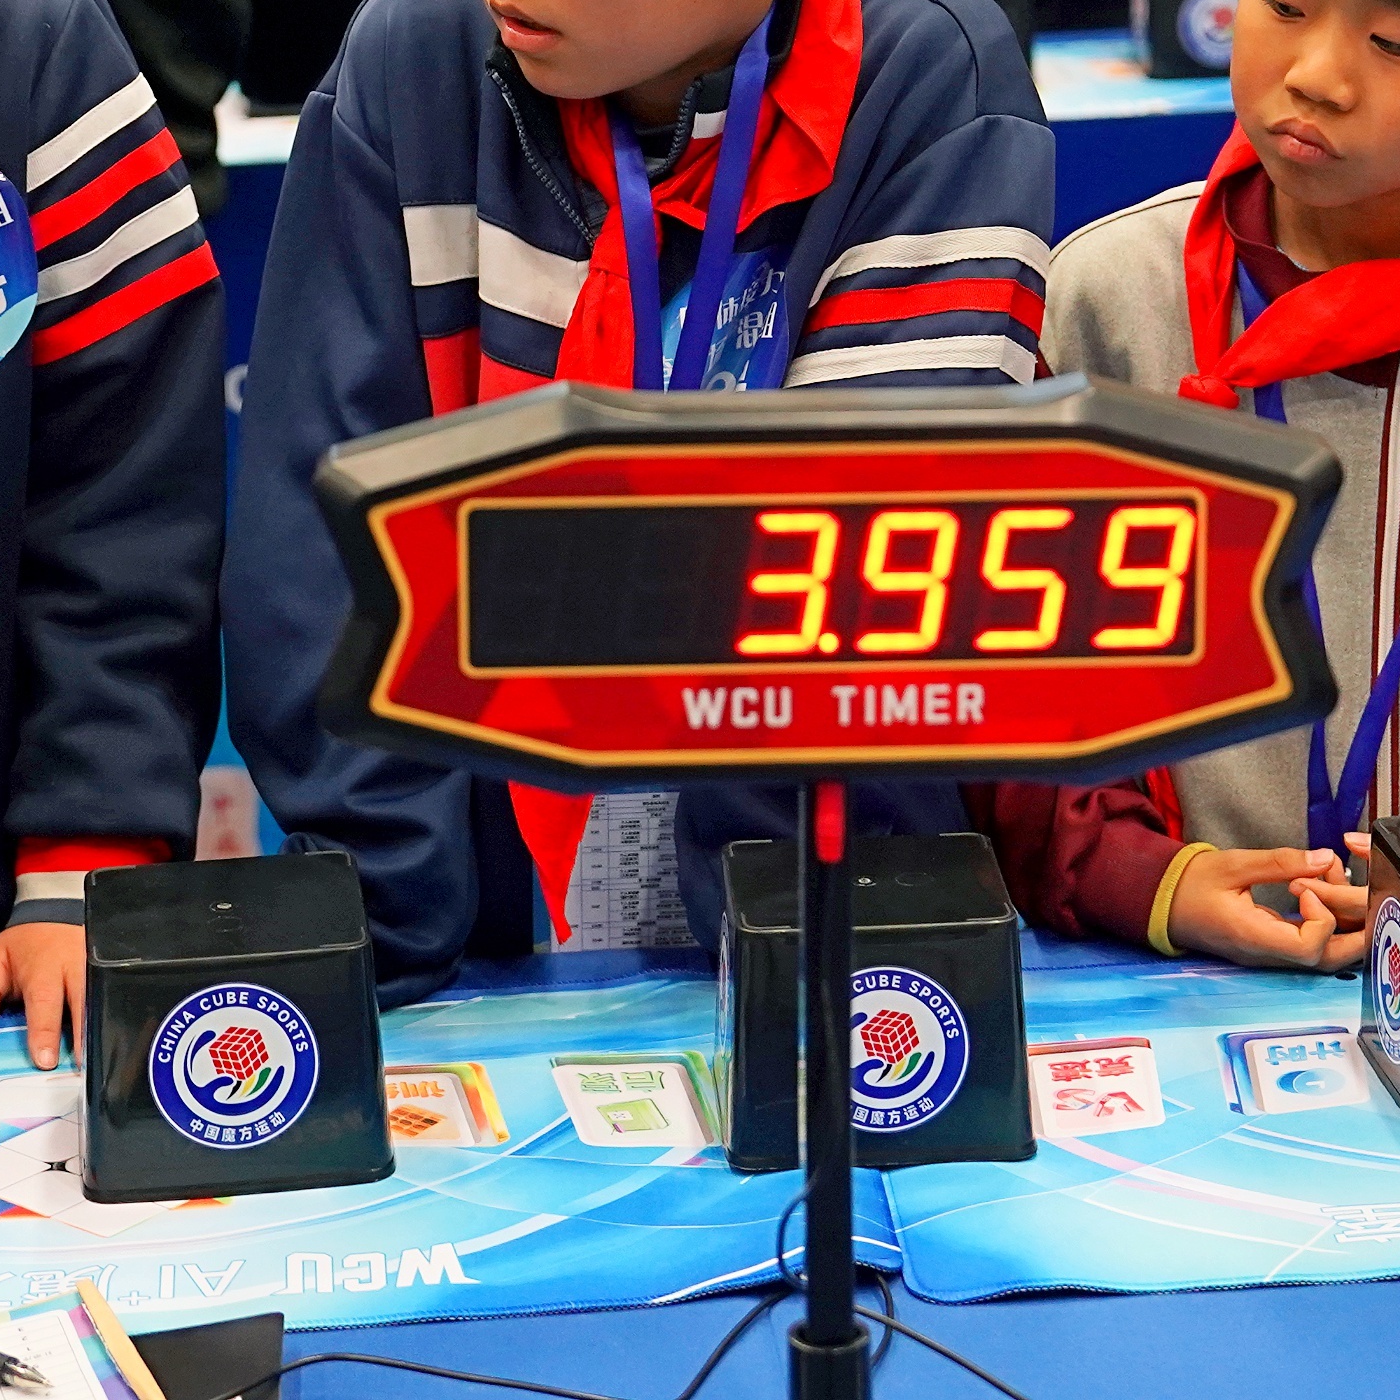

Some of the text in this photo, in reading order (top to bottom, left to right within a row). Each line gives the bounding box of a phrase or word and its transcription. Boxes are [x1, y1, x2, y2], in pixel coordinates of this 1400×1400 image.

[736, 505, 1198, 655] 3.959
[682, 683, 986, 730] WCU TIMER
[852, 973, 960, 1039] CUBE SPORTS
[158, 991, 309, 1063] CHINA CUBE SPORTS
[1046, 1054, 1135, 1082] 竞速
[1265, 1040, 1346, 1066] 计时
[573, 1070, 666, 1096] 启蒙
[189, 1111, 286, 1142] 中国魔方运动
[851, 1095, 935, 1126] 国魔方运动
[272, 1242, 481, 1295] WCU
